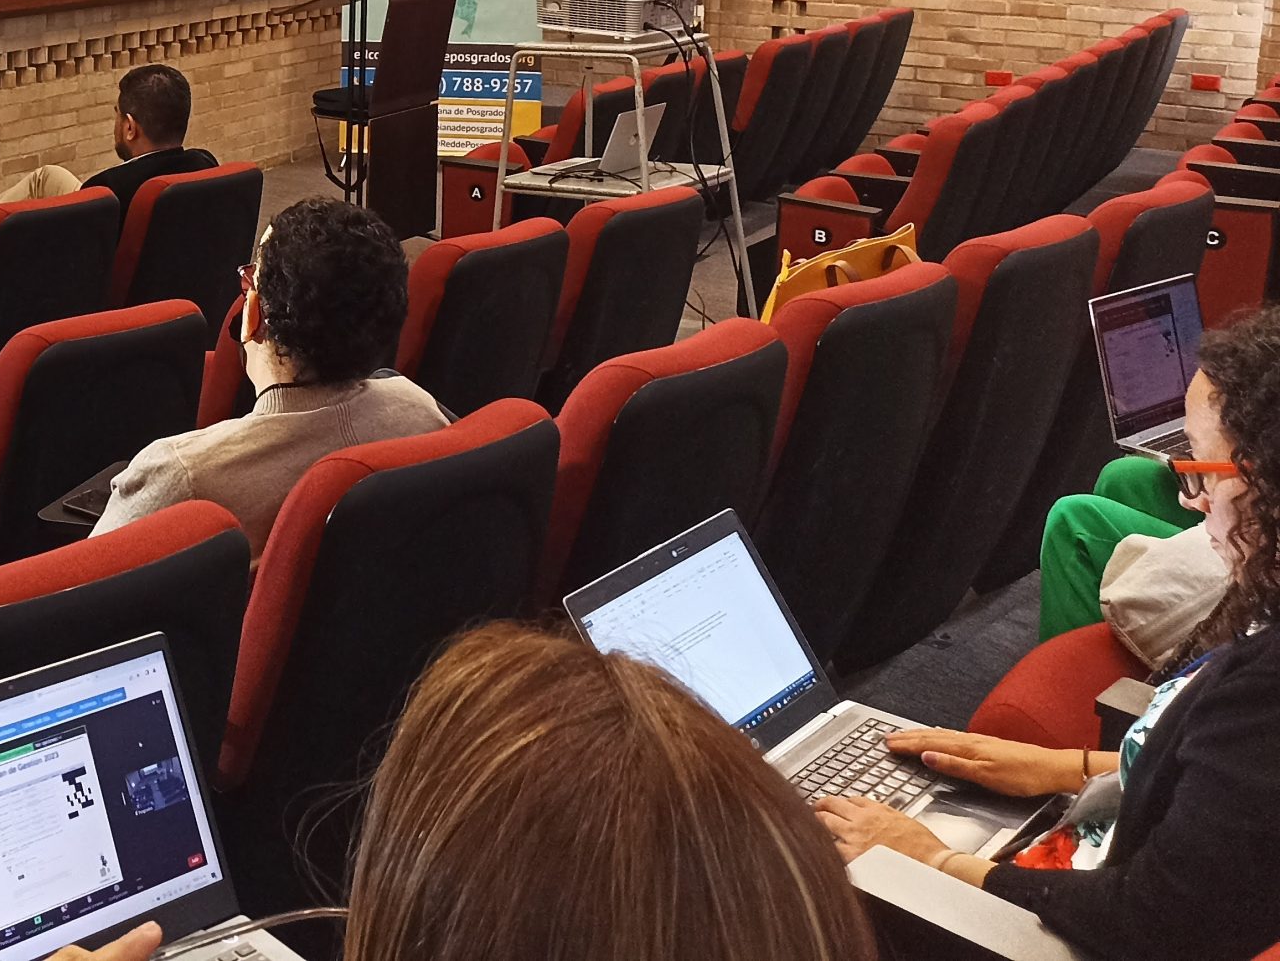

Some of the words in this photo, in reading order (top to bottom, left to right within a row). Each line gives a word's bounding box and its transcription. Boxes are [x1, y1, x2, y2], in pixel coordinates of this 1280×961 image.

[452, 77, 533, 94] 788-9257
[437, 124, 504, 134] ianadeposgrado
[471, 187, 481, 198] A
[815, 229, 826, 243] B
[1207, 231, 1219, 244] C
